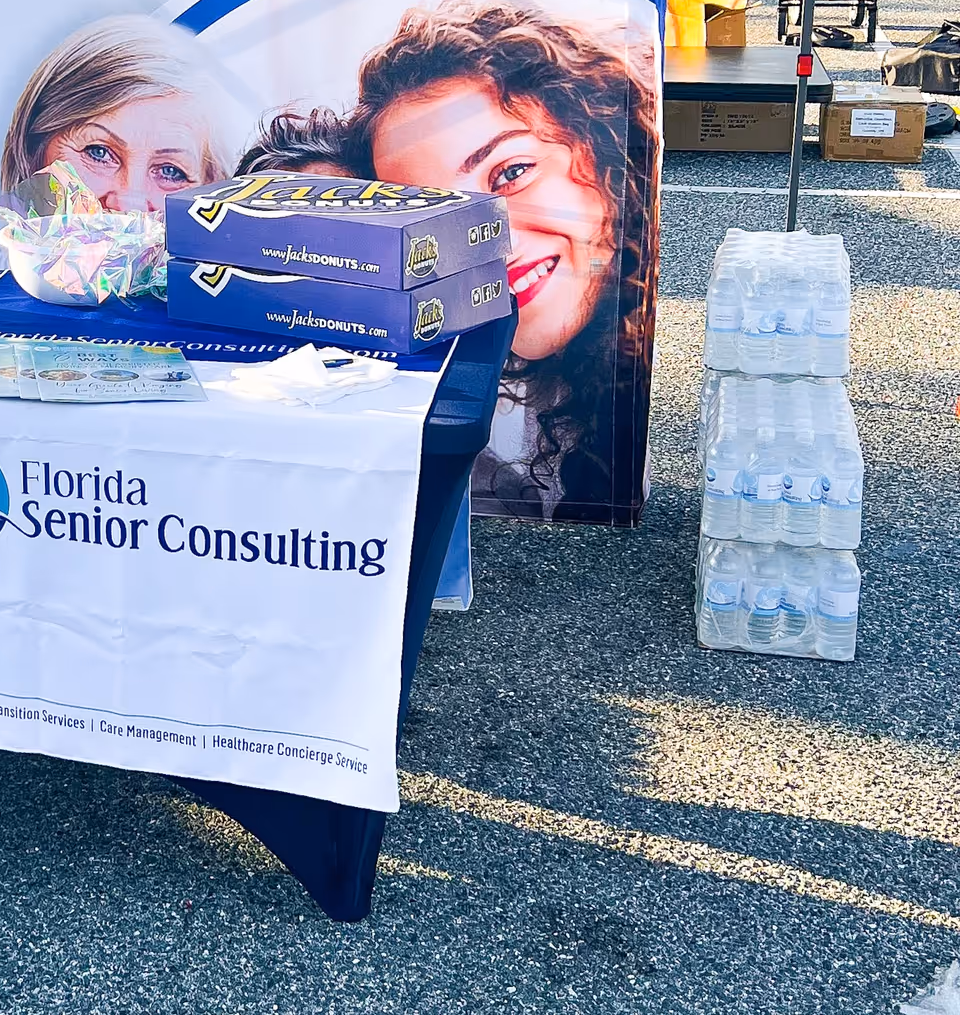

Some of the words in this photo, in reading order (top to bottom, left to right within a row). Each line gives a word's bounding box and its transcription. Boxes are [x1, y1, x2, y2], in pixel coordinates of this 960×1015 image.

[250, 199, 429, 208] DONUTS
[21, 460, 149, 506] Florida
[21, 500, 149, 550] Senior
[157, 514, 388, 577] Consulting
[42, 709, 85, 729] Services
[100, 719, 123, 737] Care
[126, 724, 197, 747] Management
[212, 735, 274, 755] Healthcare
[277, 743, 333, 765] Concierge
[336, 752, 368, 775] Service
